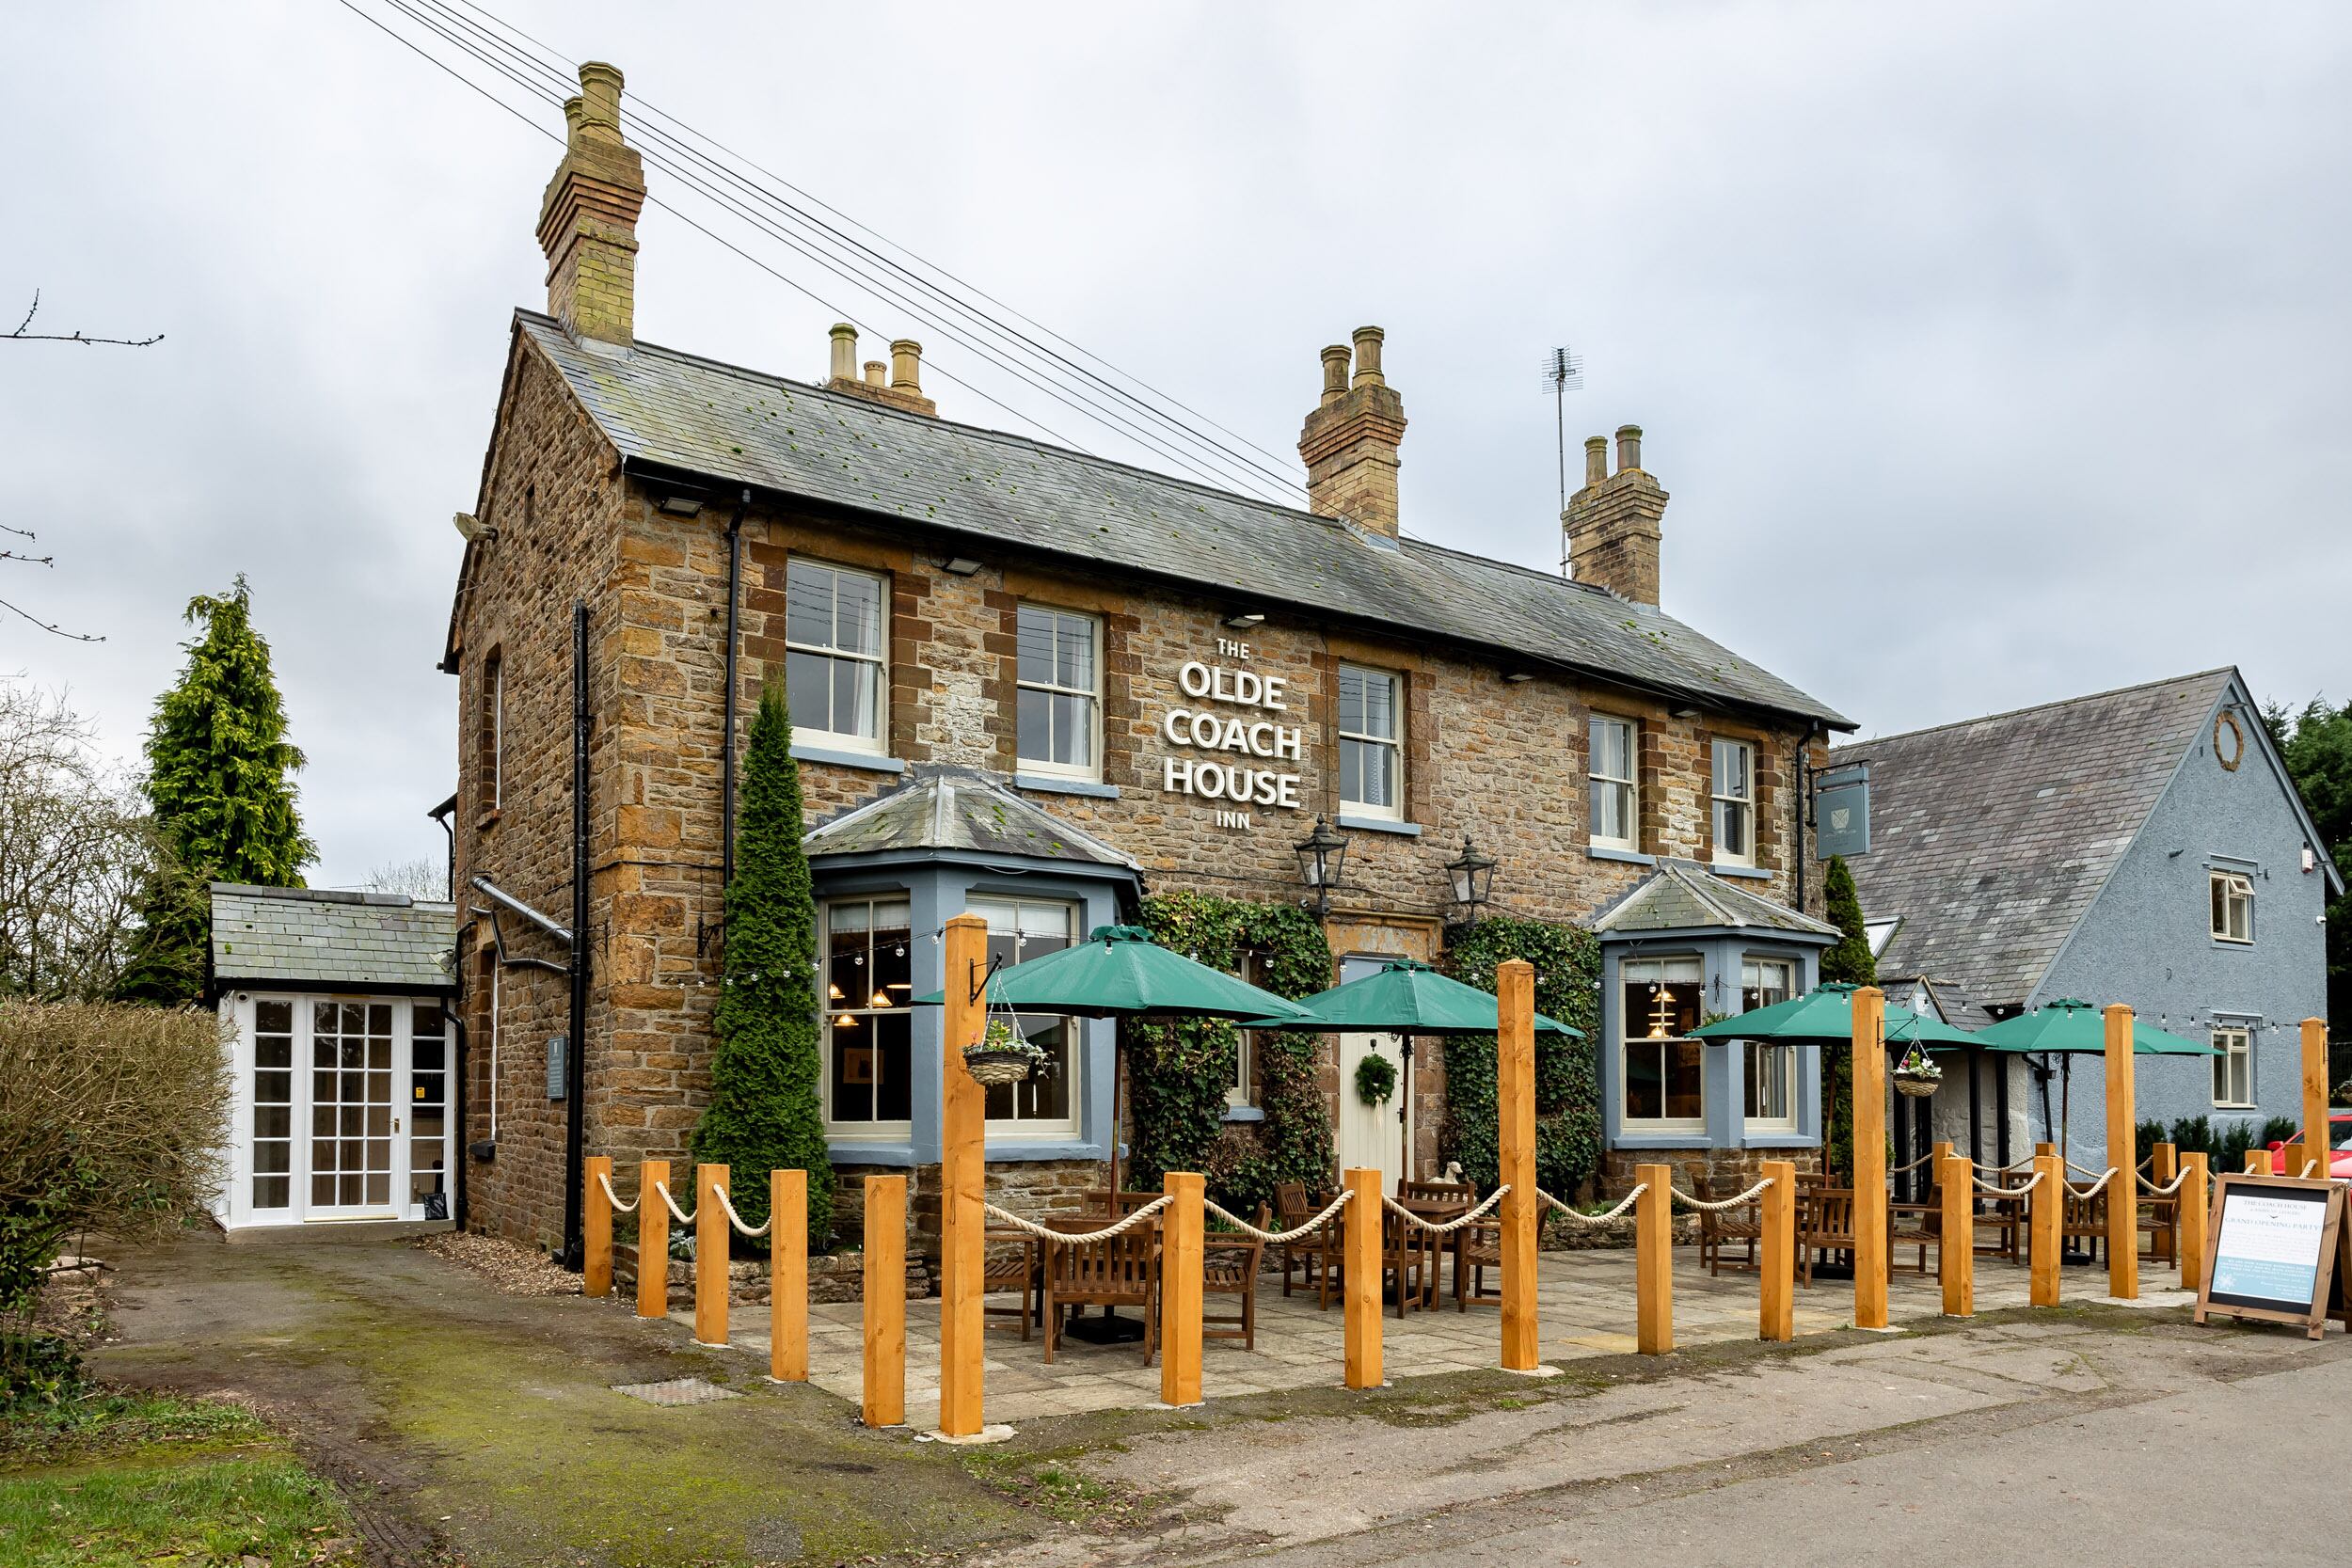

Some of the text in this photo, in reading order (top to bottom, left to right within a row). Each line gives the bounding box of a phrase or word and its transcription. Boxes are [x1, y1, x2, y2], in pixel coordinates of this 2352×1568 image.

[1217, 638, 1250, 659] THE
[1179, 661, 1287, 710] OLDE
[1164, 709, 1301, 761] COACH
[1164, 757, 1301, 808] HOUSE
[1216, 810, 1250, 830] INN
